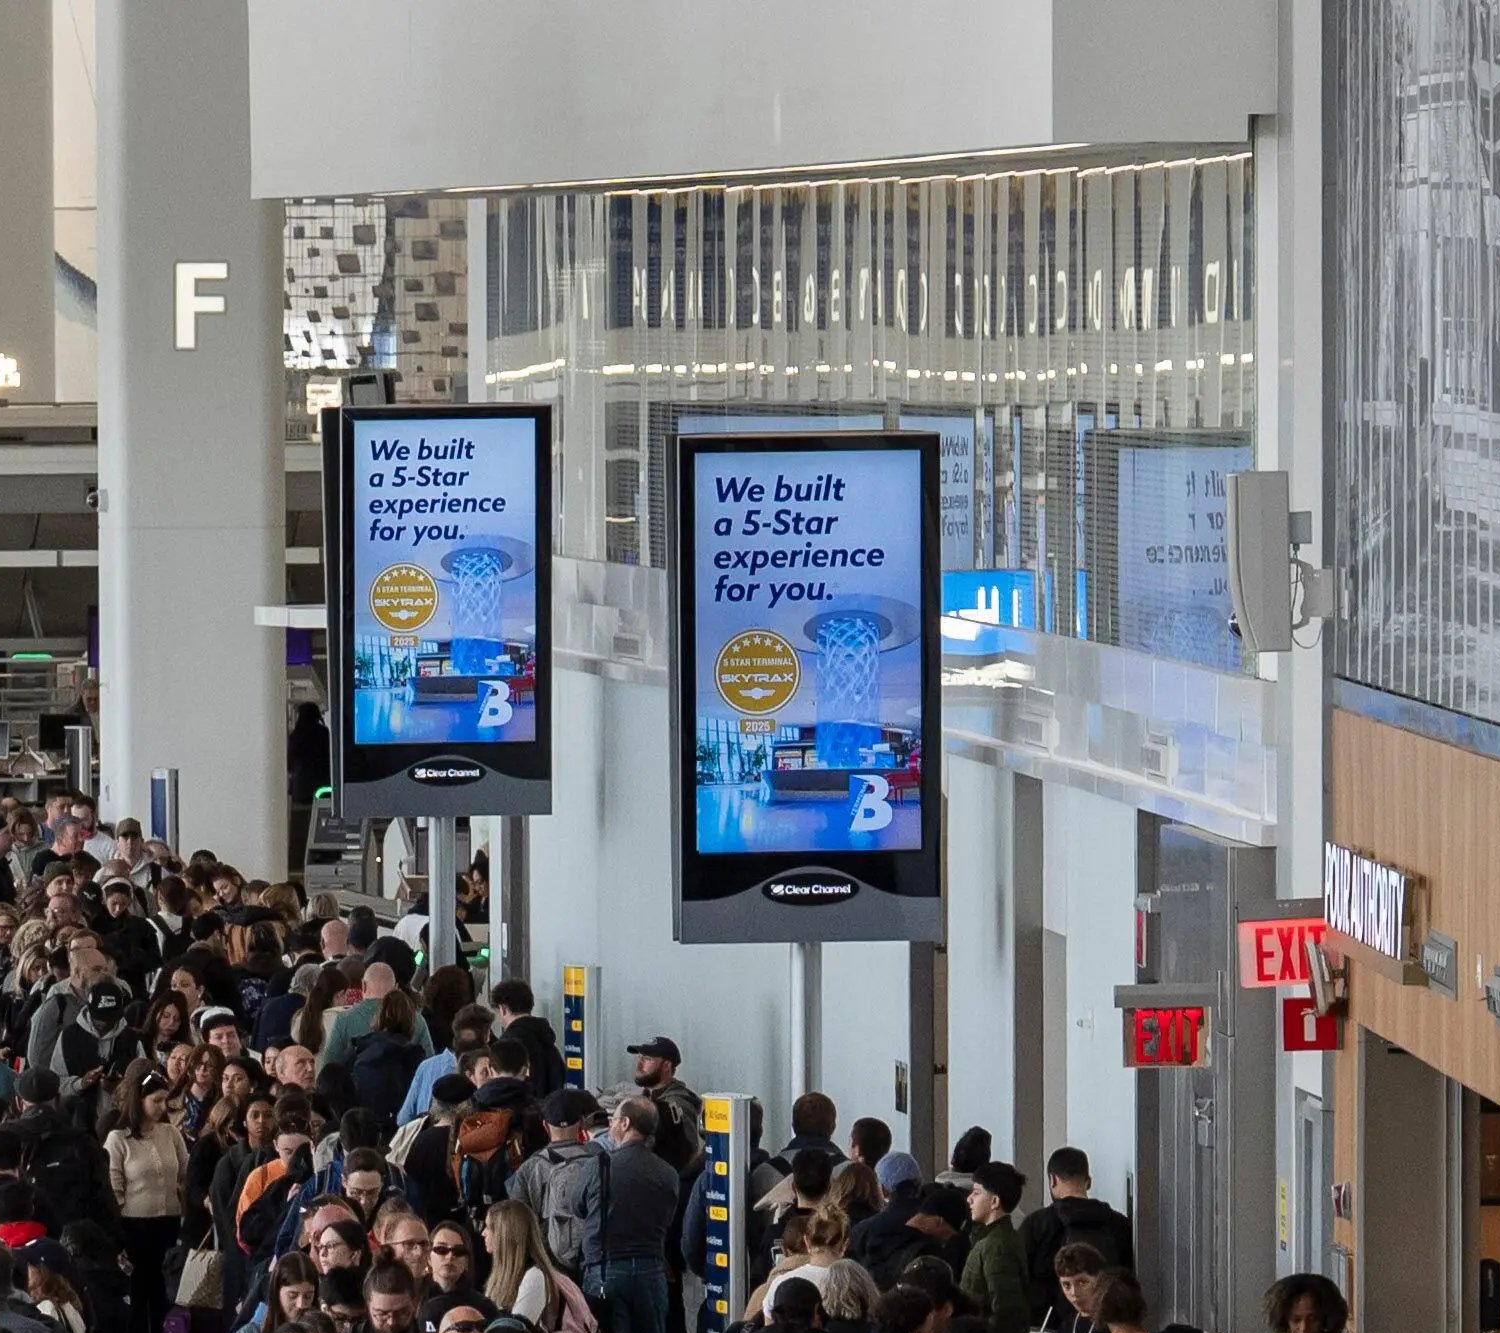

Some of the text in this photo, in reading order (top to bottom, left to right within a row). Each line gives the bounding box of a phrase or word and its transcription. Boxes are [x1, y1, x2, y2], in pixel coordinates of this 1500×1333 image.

[175, 263, 227, 349] F
[370, 438, 475, 461] We built
[369, 465, 469, 488] a 5-Star
[715, 473, 846, 503] We built
[369, 494, 507, 519] experience
[369, 518, 466, 547] for you.
[713, 508, 839, 537] a 5-Star
[713, 543, 885, 576] experience
[375, 598, 433, 607] SKYTRAX
[714, 574, 834, 609] for you.
[730, 658, 752, 667] STAR
[753, 657, 793, 666] TERMINAL
[721, 673, 794, 683] SKYTRAX
[746, 721, 771, 733] 2025
[448, 768, 480, 777] Channel
[785, 884, 852, 895] Clear Channel
[1324, 841, 1405, 961] POUR AUTHORITY
[1134, 1008, 1204, 1063] EXIT
